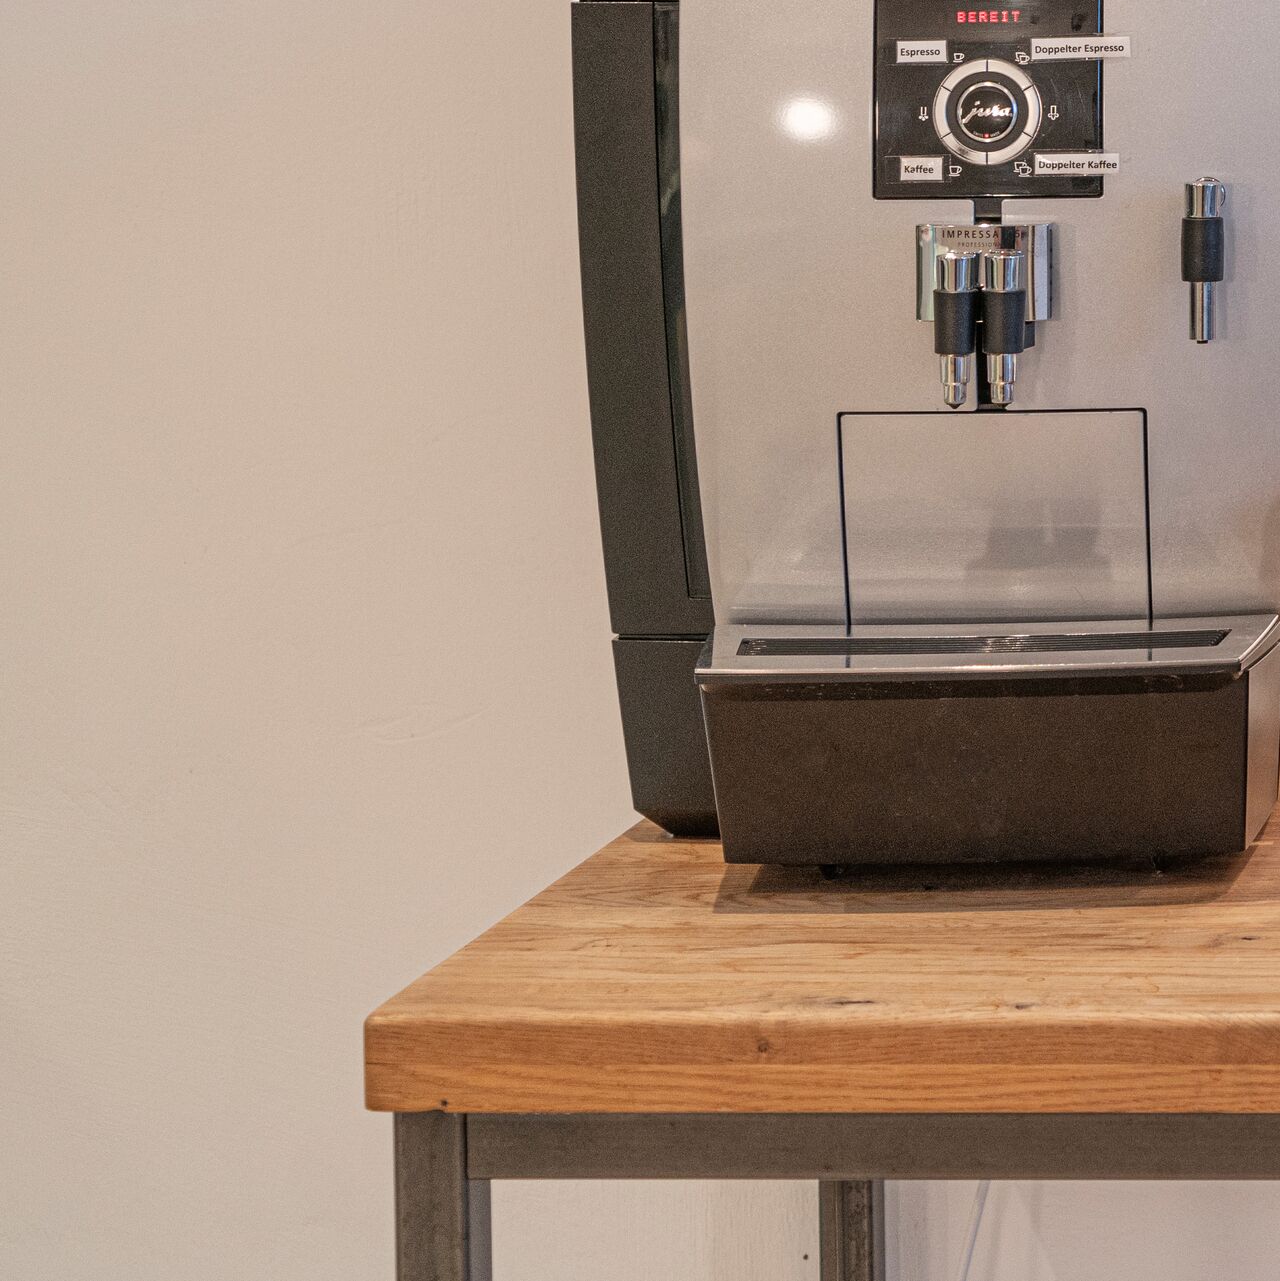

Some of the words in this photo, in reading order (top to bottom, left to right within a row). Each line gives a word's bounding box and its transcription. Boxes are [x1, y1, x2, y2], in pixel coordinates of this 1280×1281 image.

[957, 11, 1021, 23] BEREIT
[900, 47, 941, 57] Espresso
[1035, 44, 1082, 55] Doppelter
[1084, 43, 1125, 53] Espresso
[904, 165, 934, 174] Kaffee
[1038, 160, 1086, 170] Doppelter
[1088, 160, 1118, 169] Kaffee
[941, 230, 998, 238] IMPRESSA
